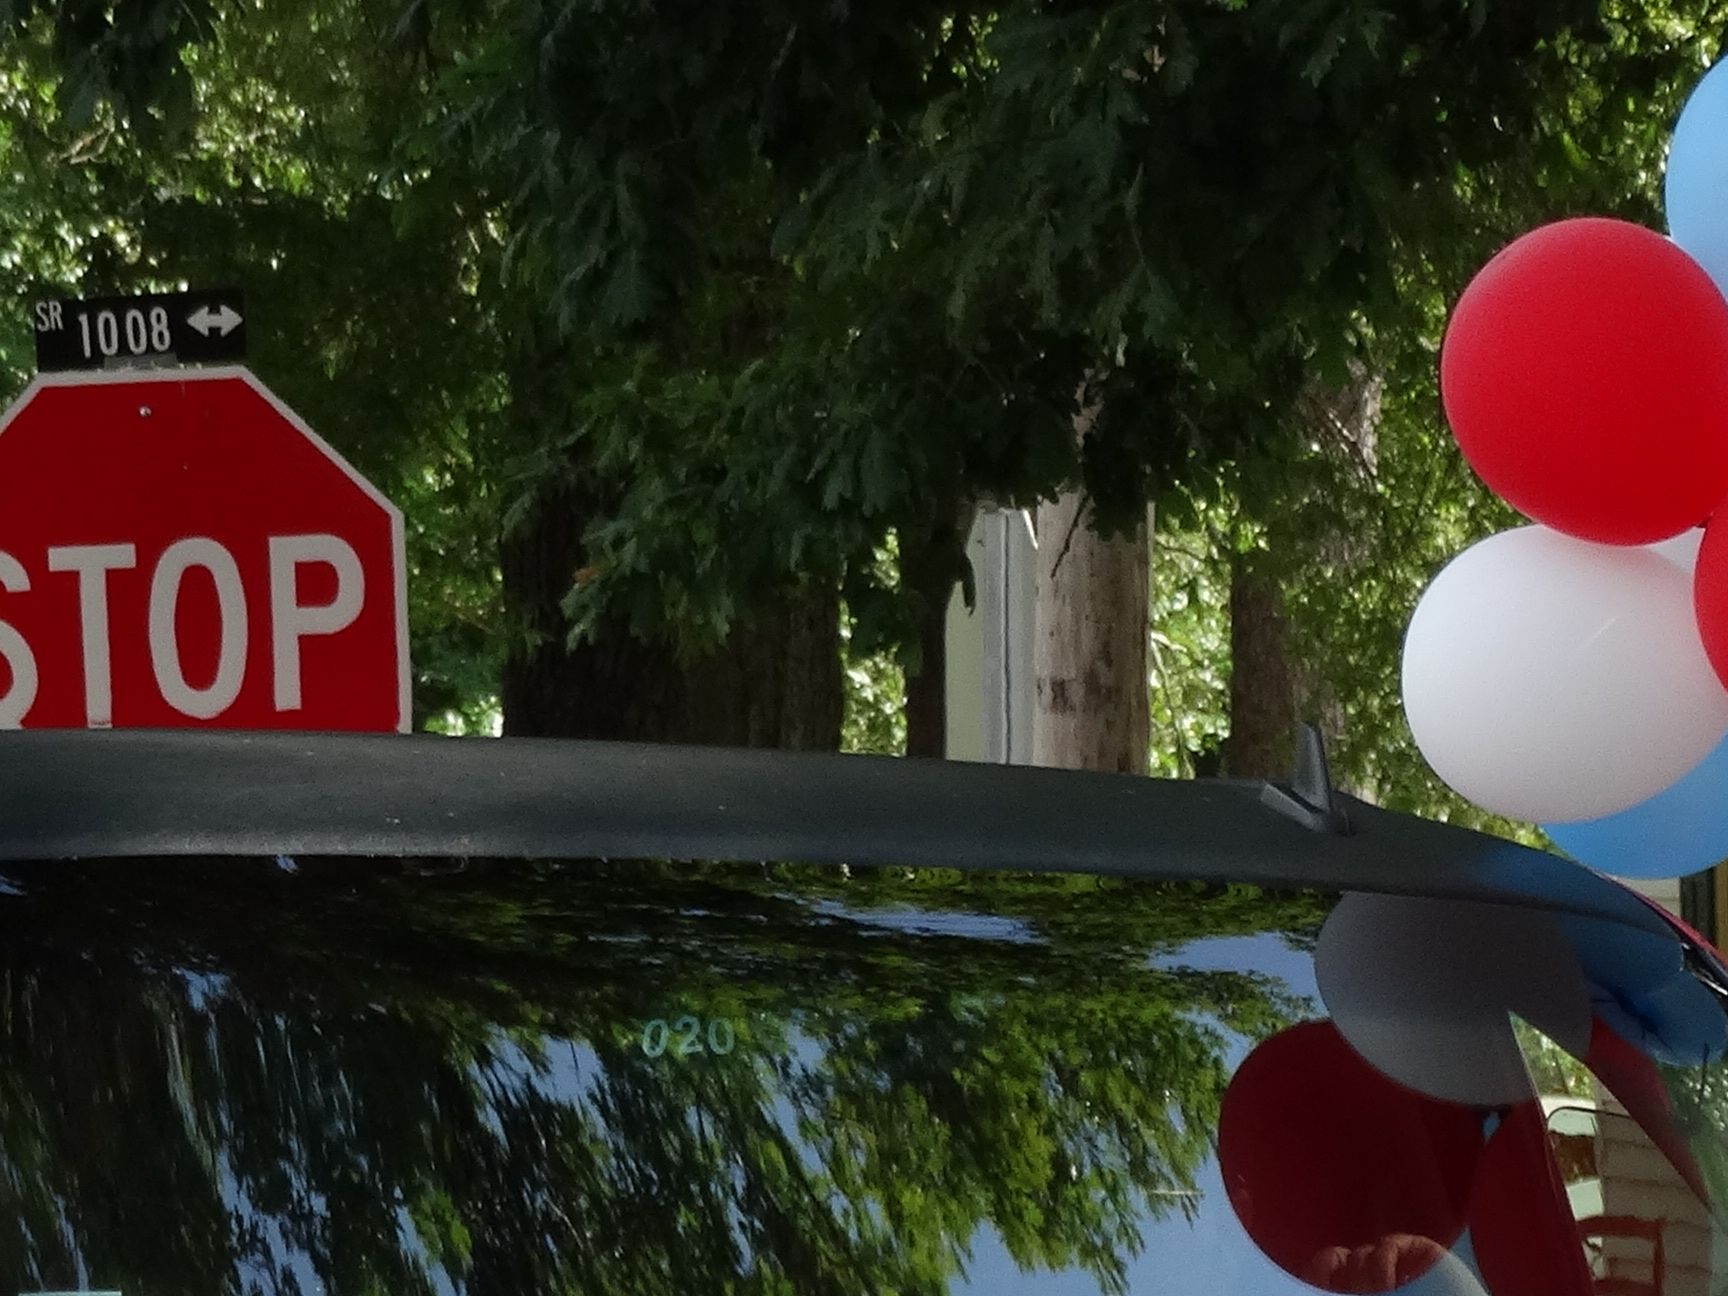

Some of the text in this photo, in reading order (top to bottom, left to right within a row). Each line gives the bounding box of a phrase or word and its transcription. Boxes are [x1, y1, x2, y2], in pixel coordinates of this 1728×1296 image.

[35, 300, 171, 358] SR 1008
[642, 1015, 735, 1057] 020
